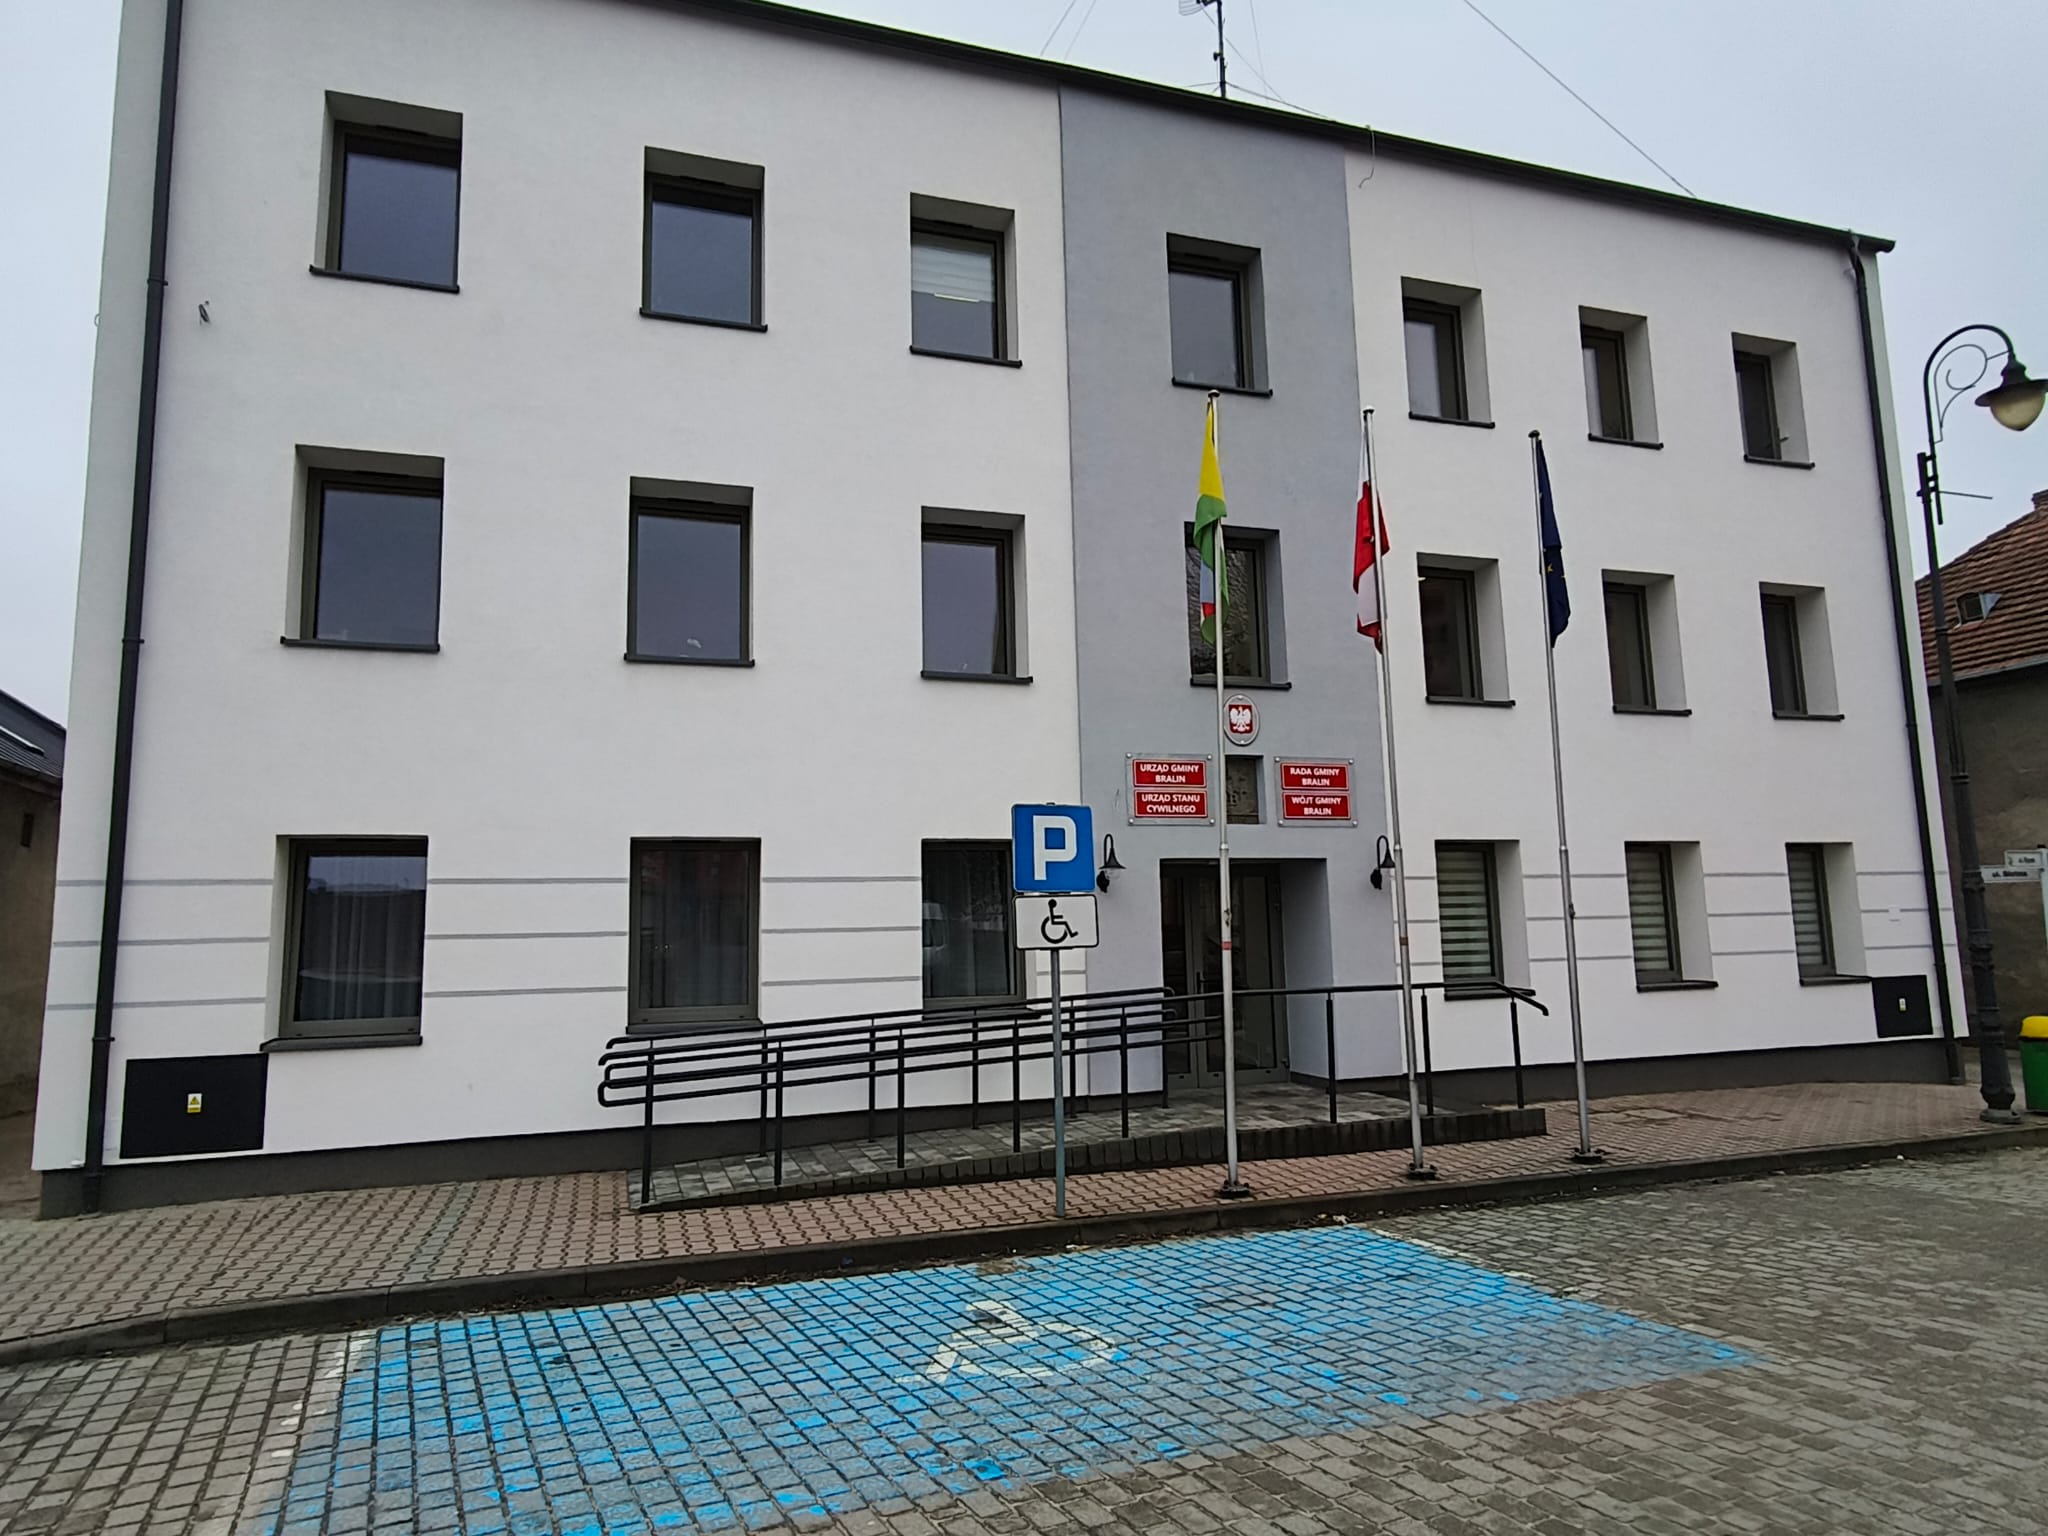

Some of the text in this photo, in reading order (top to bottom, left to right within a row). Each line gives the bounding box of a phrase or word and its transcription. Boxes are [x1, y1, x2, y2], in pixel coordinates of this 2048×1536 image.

[1140, 763, 1199, 773] URZĄD GMINY
[1290, 767, 1340, 776] RADA GMINY
[1155, 774, 1186, 783] BRALIN
[1301, 778, 1330, 786] BRALIN
[1141, 793, 1200, 803] URZĄD STANU
[1291, 795, 1342, 805] WÓJT GMINY
[1146, 804, 1196, 813] CYWILNEGO
[1303, 807, 1332, 815] BRALIN
[1033, 815, 1077, 881] P
